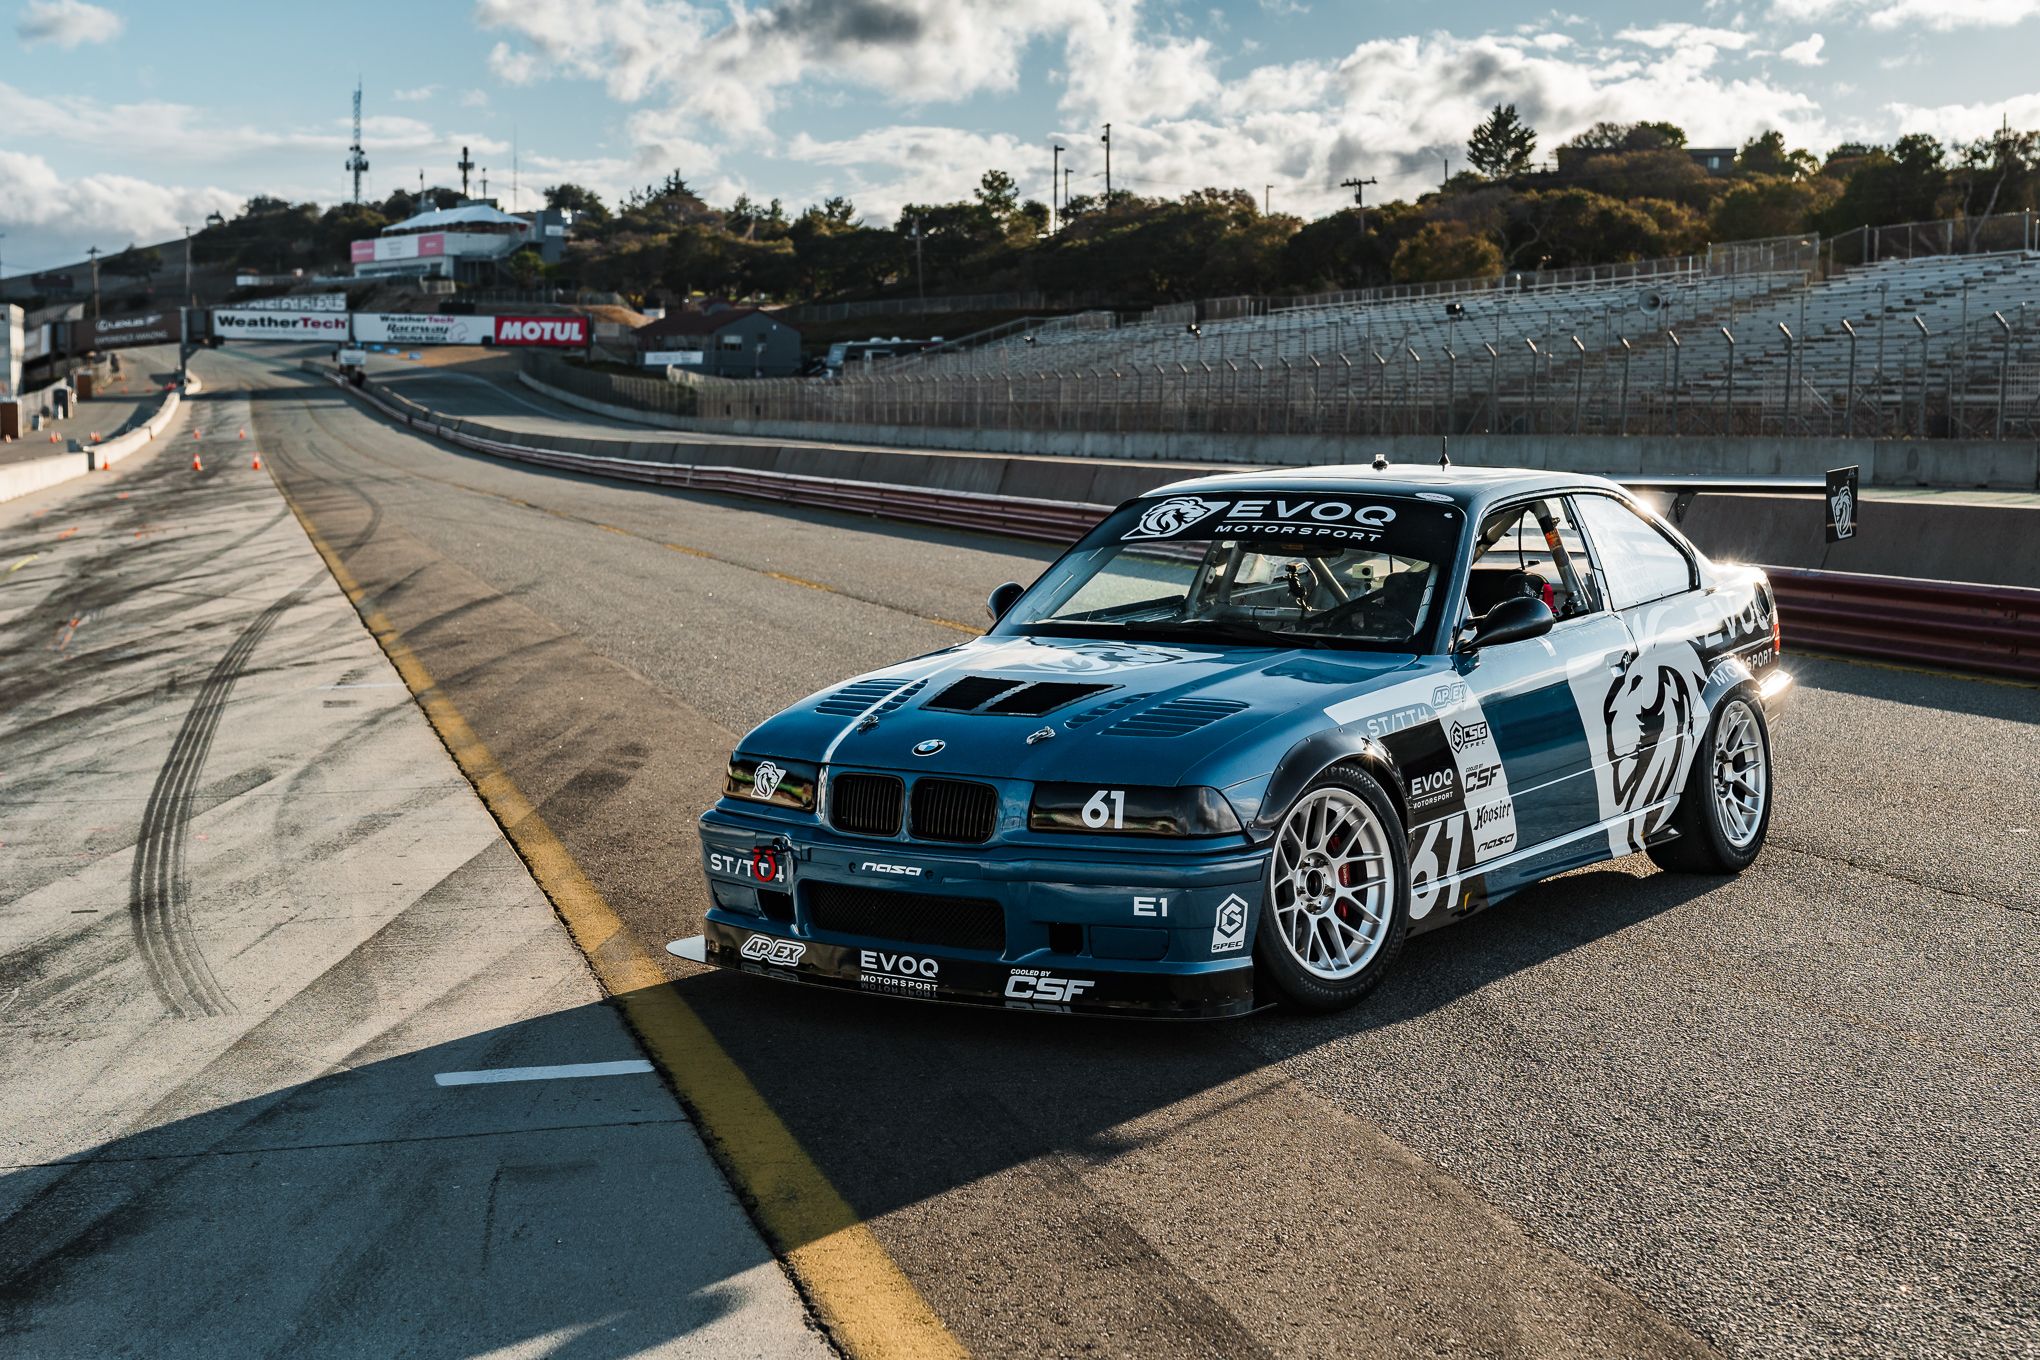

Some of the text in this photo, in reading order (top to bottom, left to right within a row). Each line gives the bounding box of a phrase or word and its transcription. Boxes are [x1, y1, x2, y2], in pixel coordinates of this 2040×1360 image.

[217, 315, 347, 330] WeatherTech
[500, 321, 583, 341] MOTUL
[1226, 500, 1396, 527] EVOQ
[1215, 525, 1382, 542] MOTORSPORT
[1366, 706, 1430, 738] ST/TT4
[1463, 722, 1488, 742] CSG
[1465, 740, 1486, 749] SPEC
[1411, 768, 1454, 796] EVOQ
[1465, 763, 1501, 793] CSF
[1081, 790, 1125, 829] 61
[1412, 791, 1454, 809] MOTORSPORT
[1473, 800, 1511, 831] Hoosier
[861, 862, 922, 877] nasa
[1409, 814, 1464, 920] 61
[1133, 896, 1168, 917] E1
[744, 937, 803, 964] APEX
[1212, 940, 1243, 950] SPEC
[860, 950, 939, 977] EVOQ
[1010, 968, 1040, 976] COOLED
[860, 974, 939, 991] MOTORSPORT
[1004, 975, 1096, 1002] CSF
